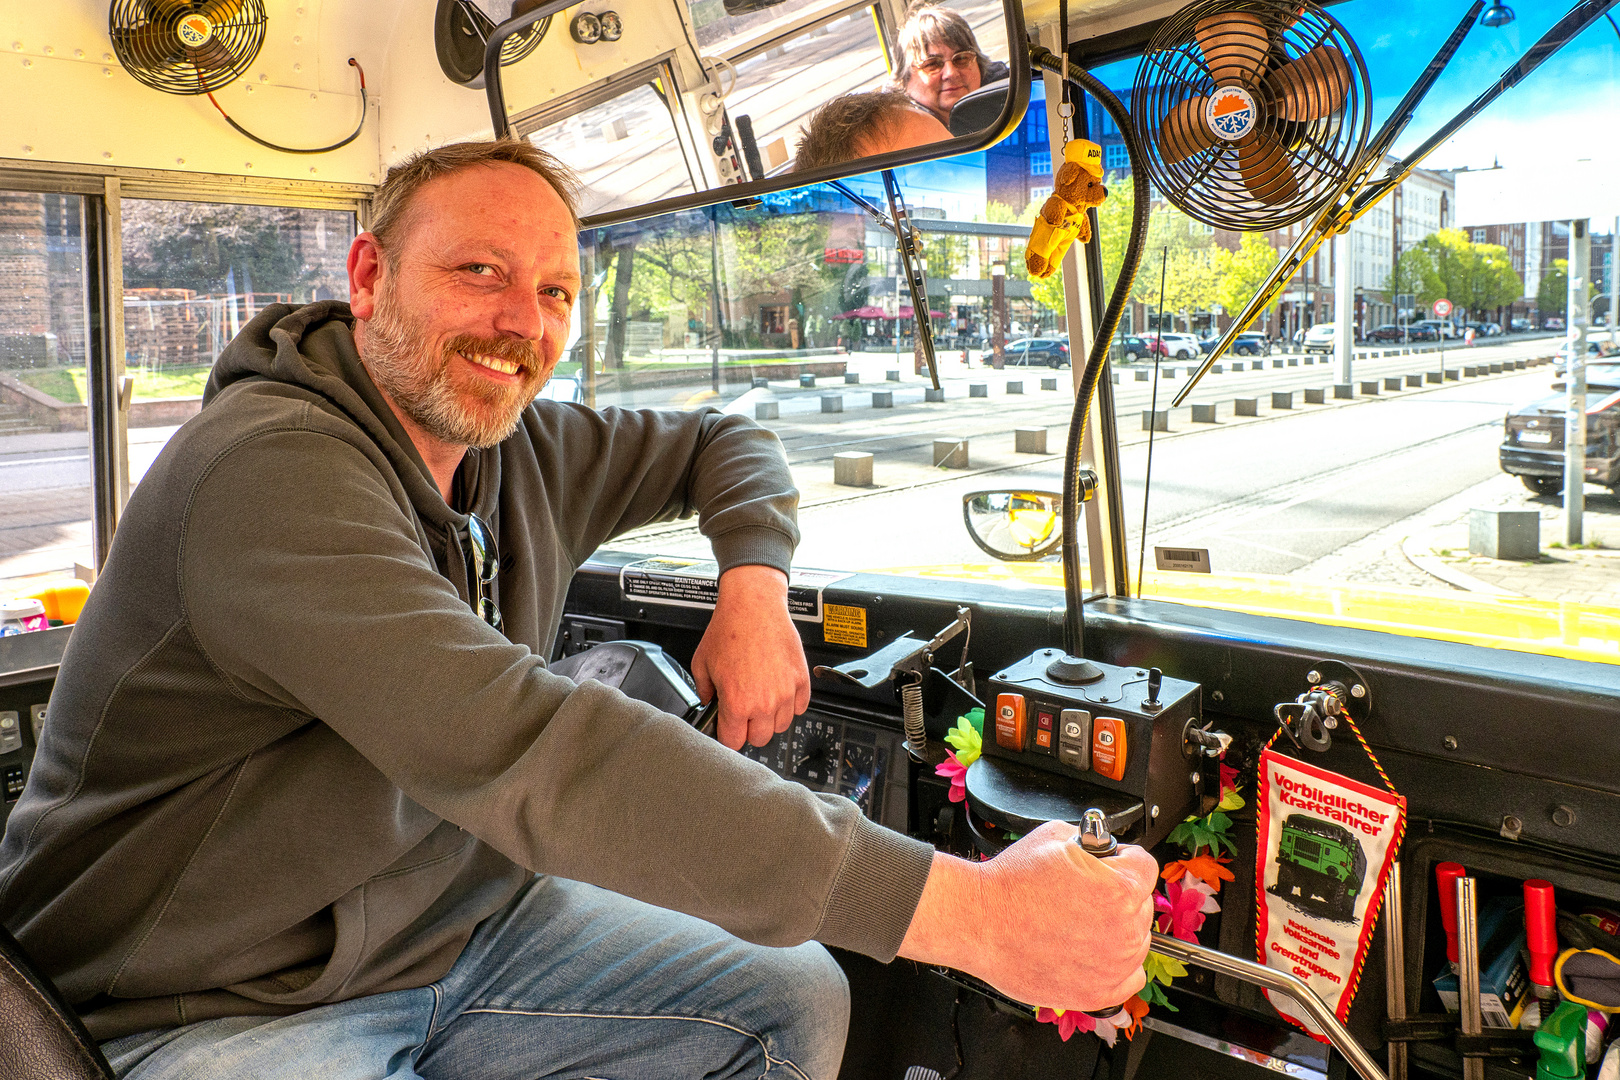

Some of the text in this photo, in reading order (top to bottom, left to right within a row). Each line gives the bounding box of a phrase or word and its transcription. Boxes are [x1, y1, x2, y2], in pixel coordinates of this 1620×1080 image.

[674, 577, 714, 587] MAINTENANCE
[828, 605, 861, 618] WARNING
[1274, 771, 1390, 825] Vorbildlicher
[1279, 788, 1382, 837] Kraftfahrer
[1283, 924, 1340, 960] Volksarmee
[1288, 918, 1336, 947] Nationale
[1270, 941, 1342, 985] Grenztruppen
[1298, 945, 1319, 961] und
[1292, 965, 1312, 980] der
